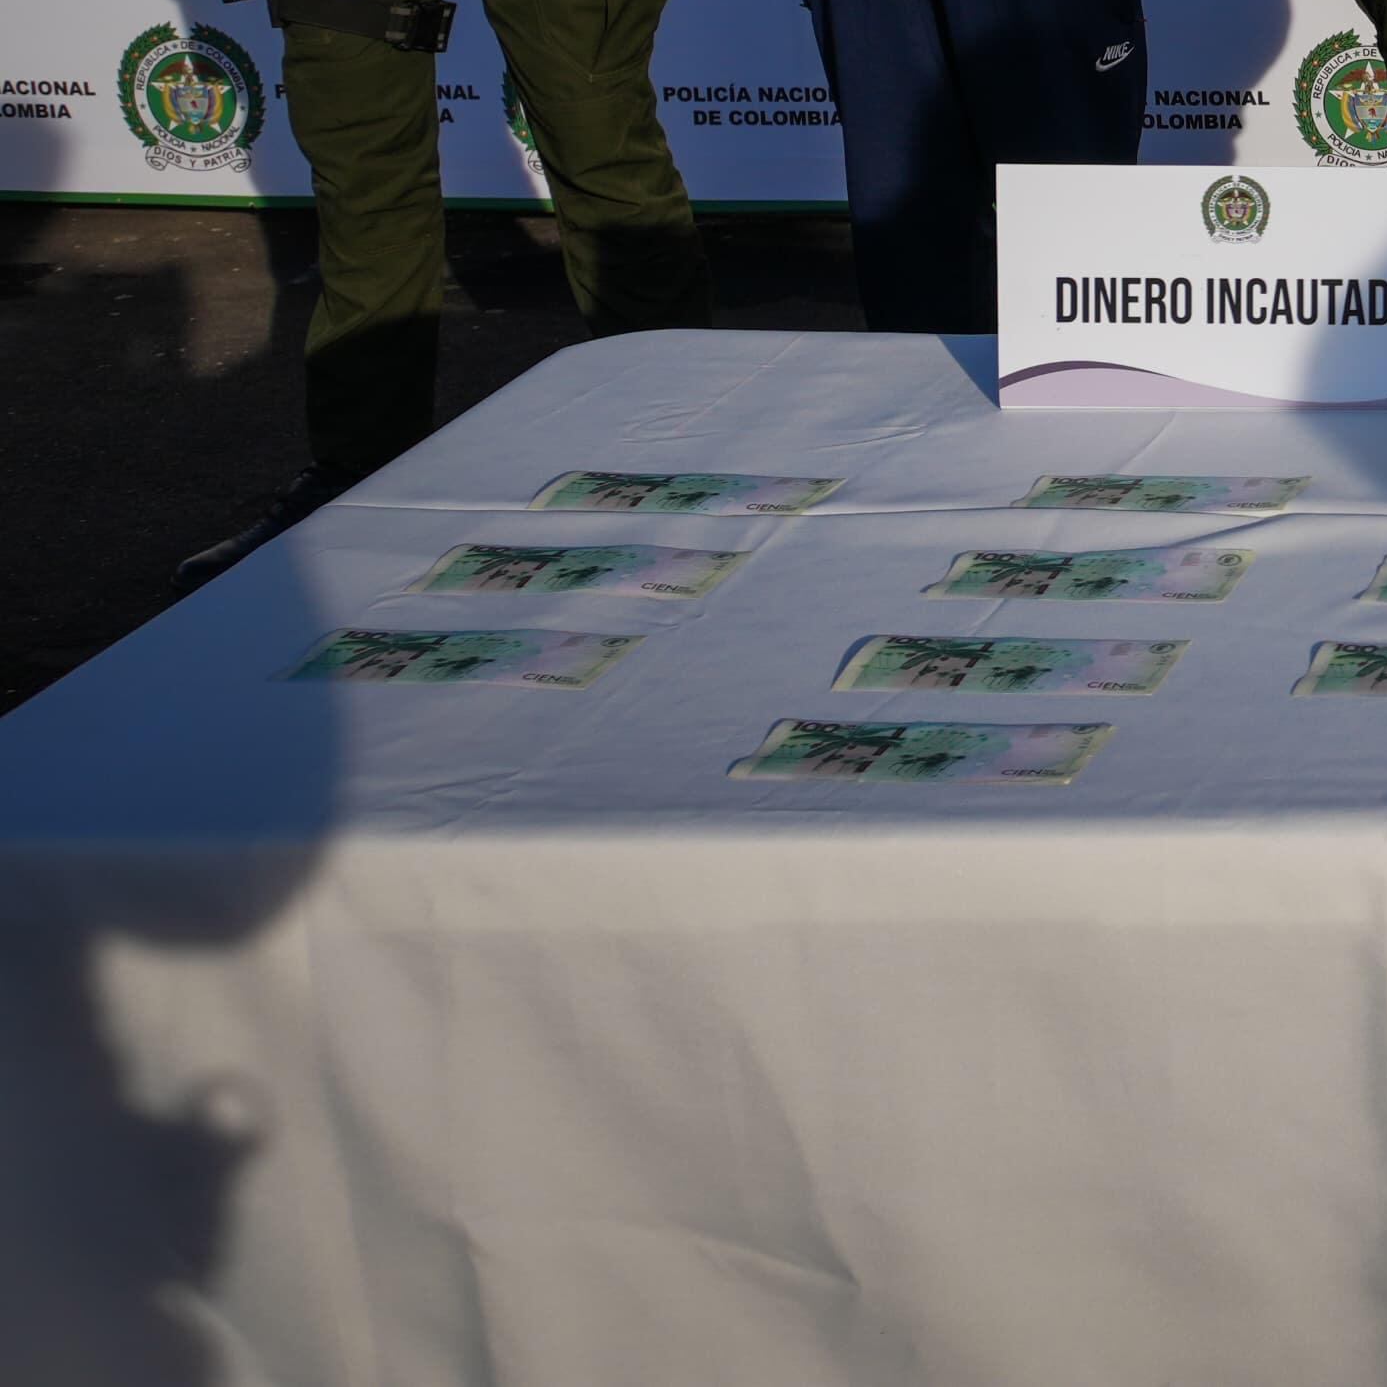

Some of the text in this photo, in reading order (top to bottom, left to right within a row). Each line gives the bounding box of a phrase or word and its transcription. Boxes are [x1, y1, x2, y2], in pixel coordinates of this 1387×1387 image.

[1103, 41, 1130, 61] NIKE
[0, 81, 97, 96] ACIONAL
[663, 84, 834, 103] POLICÍA NACIO
[1154, 90, 1270, 106] NACIONAL
[694, 110, 722, 125] DE
[1142, 114, 1242, 130] OLOMBIA
[1055, 276, 1192, 324] DINERO
